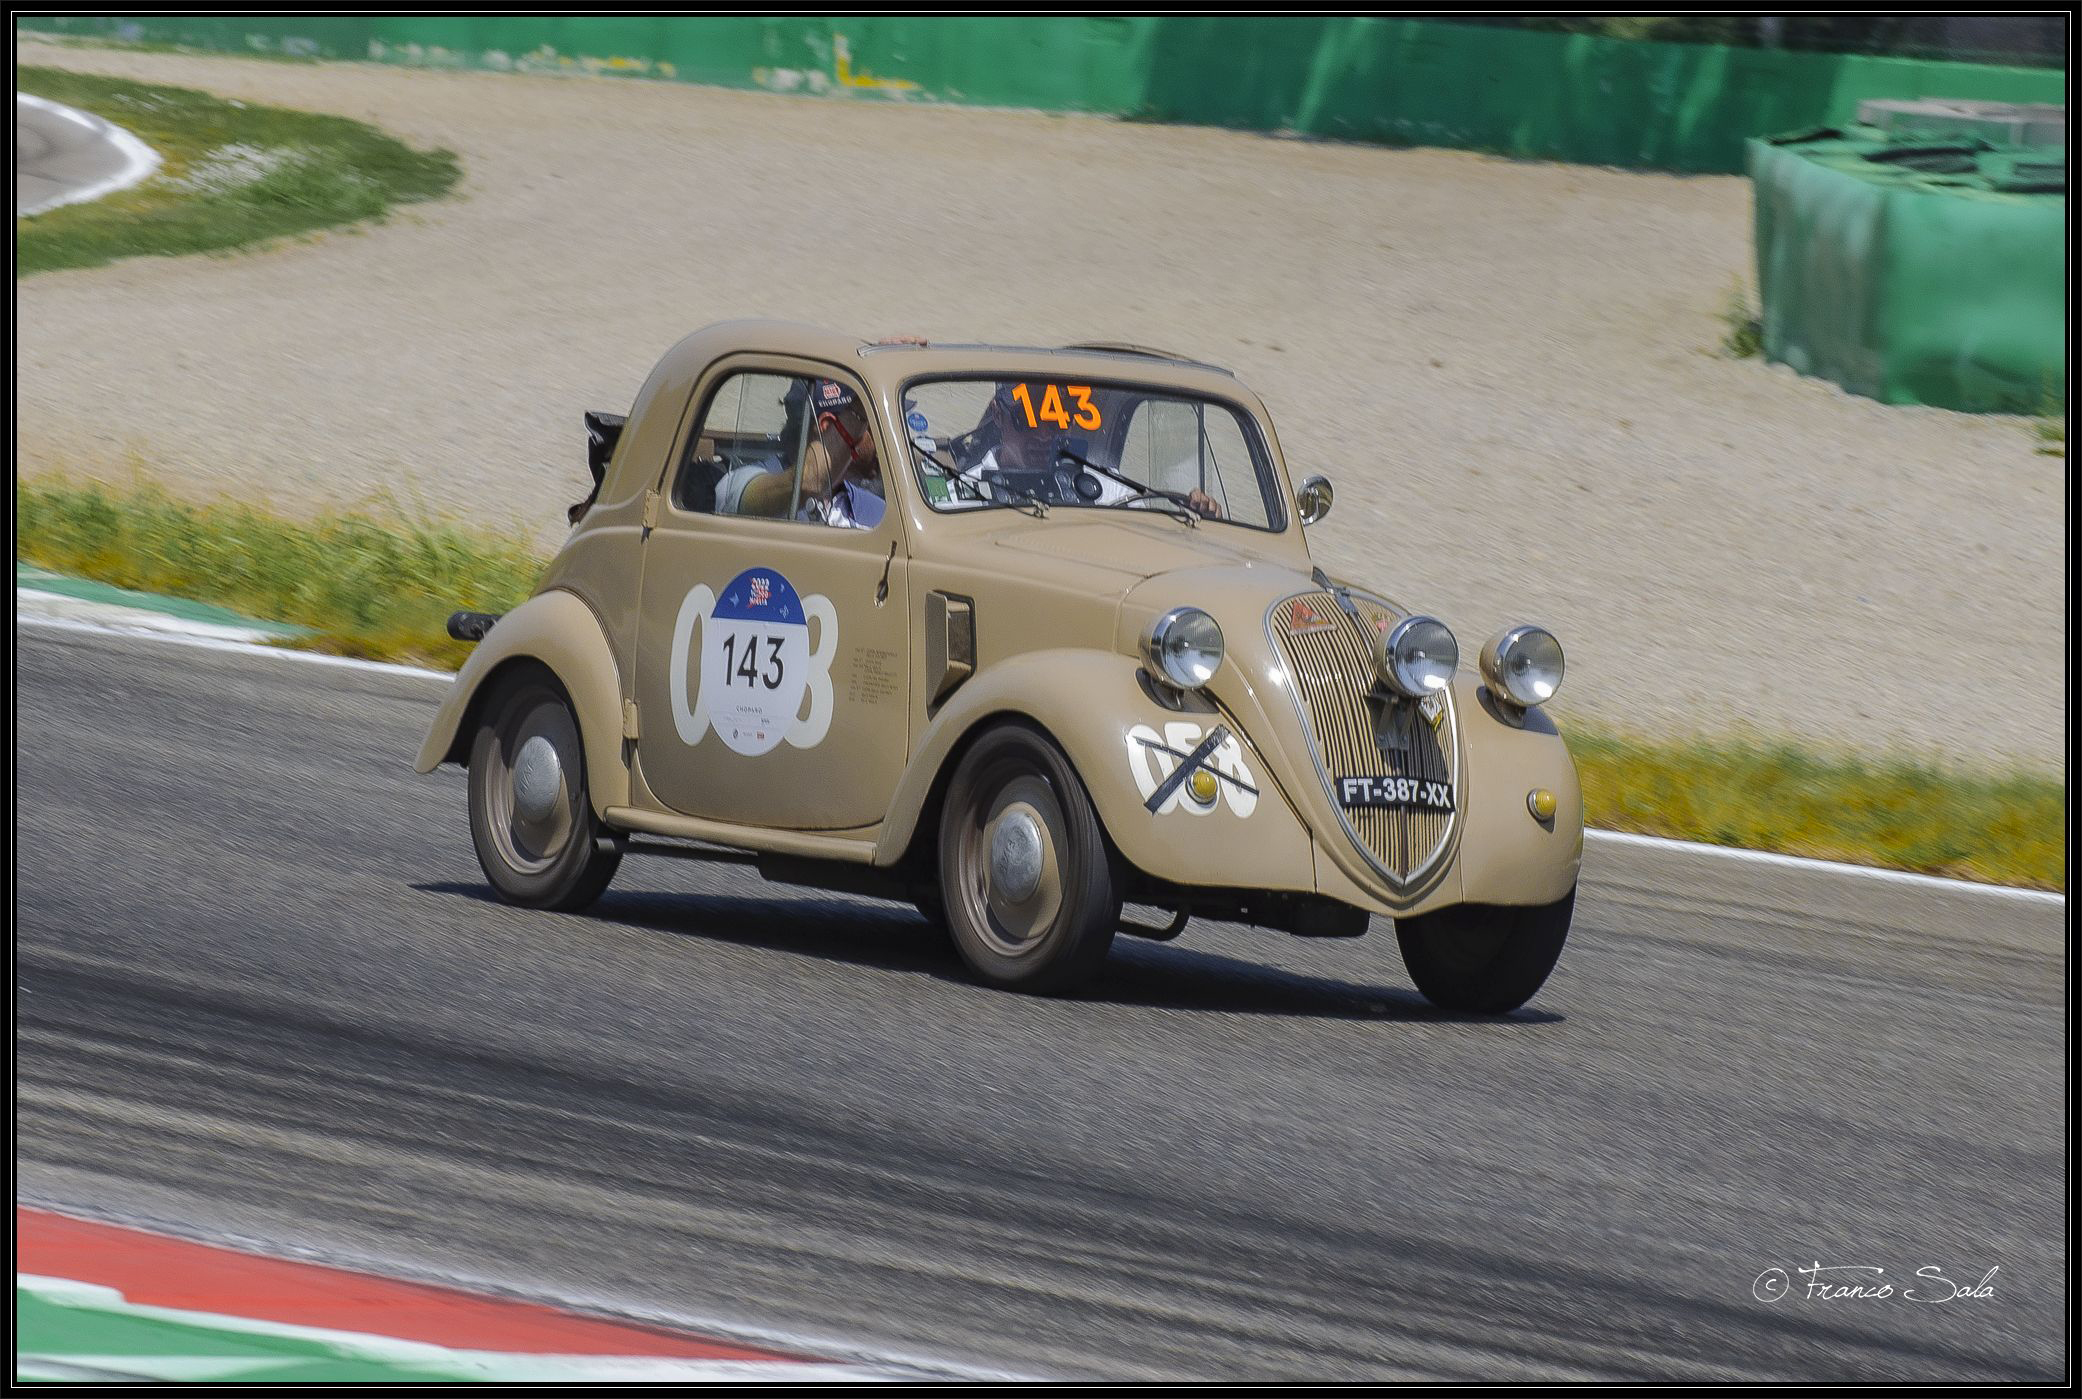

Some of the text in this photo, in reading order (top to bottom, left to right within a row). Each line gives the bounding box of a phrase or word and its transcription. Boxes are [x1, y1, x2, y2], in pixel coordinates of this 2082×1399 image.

[1012, 383, 1101, 430] 143
[722, 632, 786, 690] 143
[1343, 777, 1451, 809] FT-387-XX
